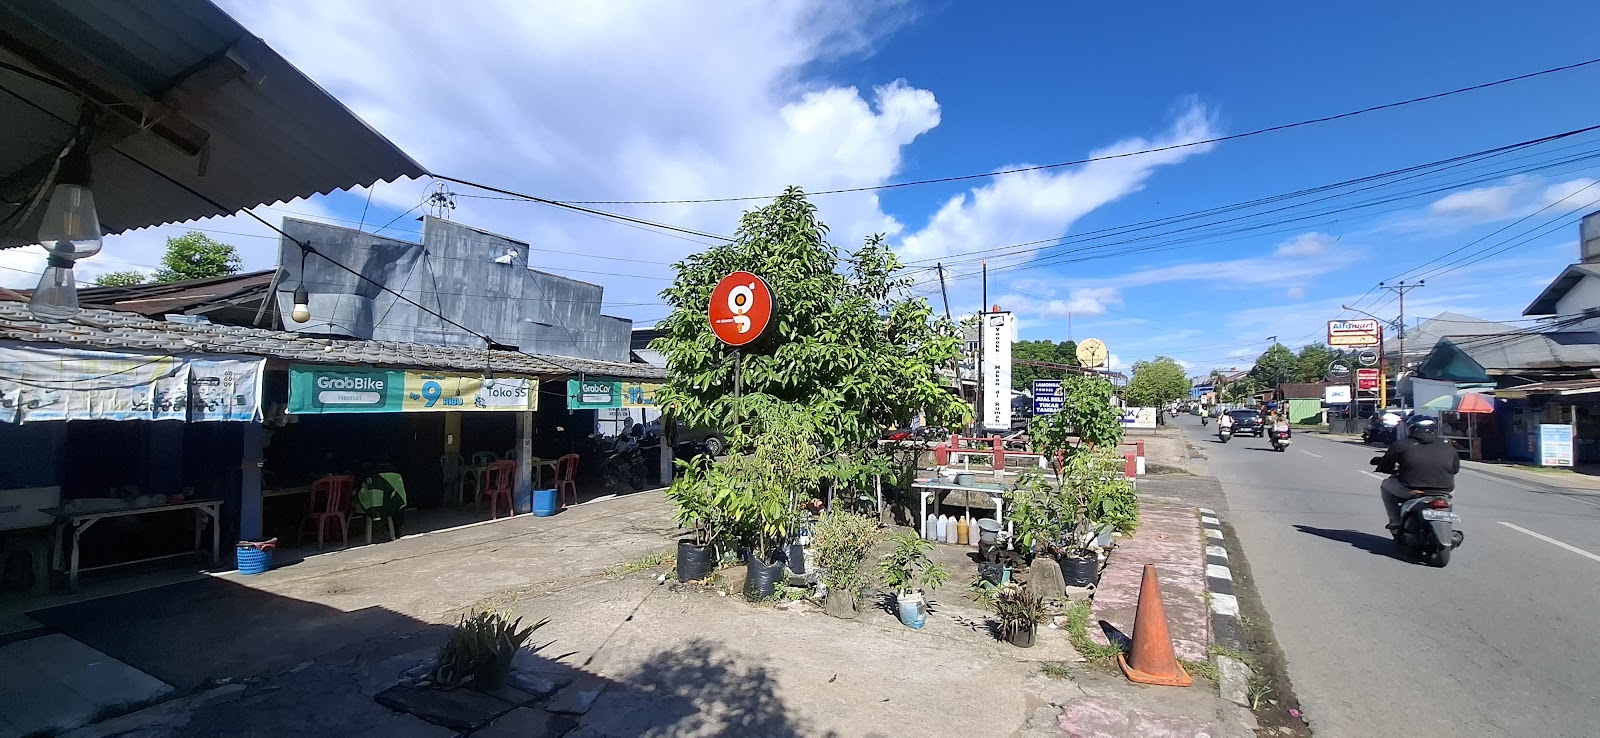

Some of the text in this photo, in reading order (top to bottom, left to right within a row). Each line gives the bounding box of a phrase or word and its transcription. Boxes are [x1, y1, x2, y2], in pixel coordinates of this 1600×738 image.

[1333, 322, 1374, 330] Alfamart
[317, 377, 384, 390] GrabBike
[582, 384, 611, 393] GrabCar
[422, 381, 442, 408] 9
[442, 397, 463, 406] RIBU
[488, 386, 527, 398] Toko SS
[338, 394, 362, 402] Hemat
